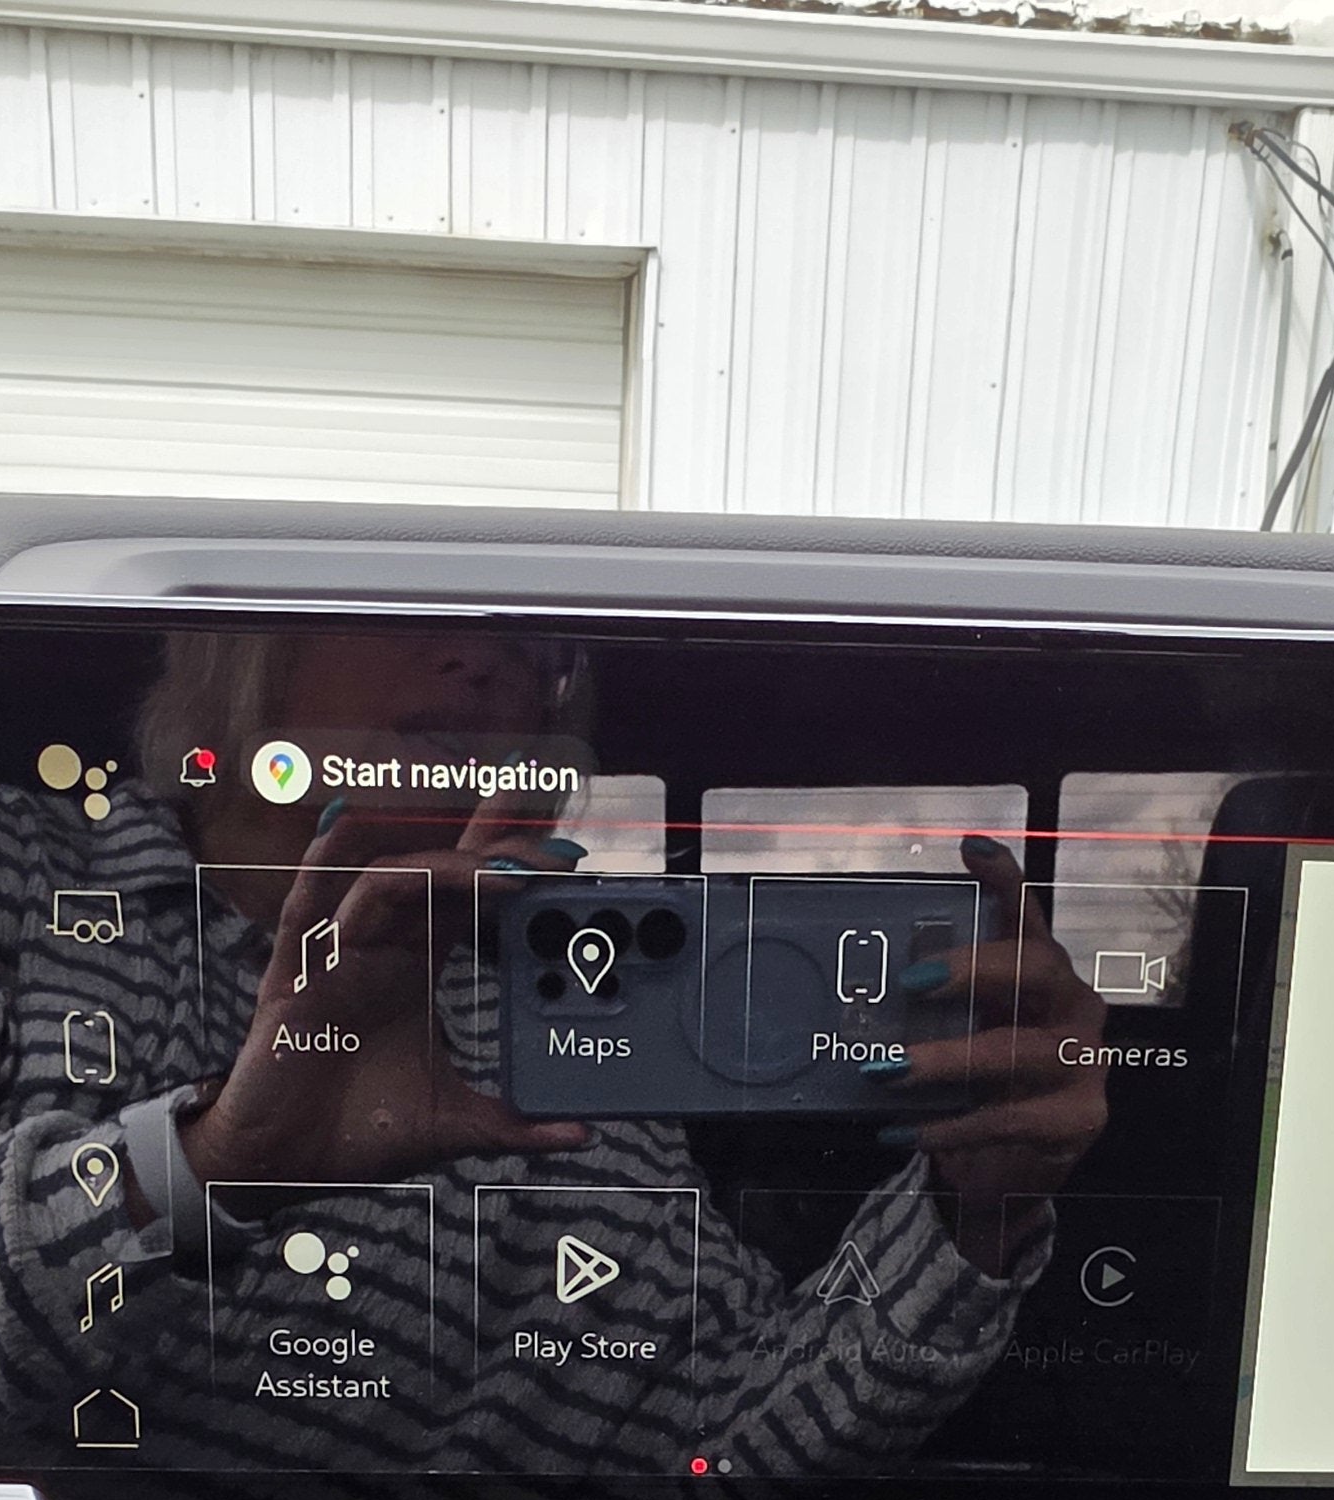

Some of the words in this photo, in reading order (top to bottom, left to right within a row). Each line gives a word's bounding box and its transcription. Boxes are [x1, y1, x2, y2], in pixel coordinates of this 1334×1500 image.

[321, 755, 402, 790] Start
[410, 758, 580, 796] navigation
[272, 1024, 361, 1054] Audio
[547, 1028, 632, 1060] Maps
[811, 1033, 905, 1064] Phone
[1057, 1038, 1188, 1069] Cameras
[268, 1330, 375, 1364] Google
[513, 1332, 573, 1365] Play
[580, 1331, 656, 1360] Store
[871, 1336, 939, 1362] Auto
[1004, 1339, 1083, 1369] Apple
[1094, 1339, 1201, 1372] CarPlay
[255, 1372, 391, 1399] Assistant
